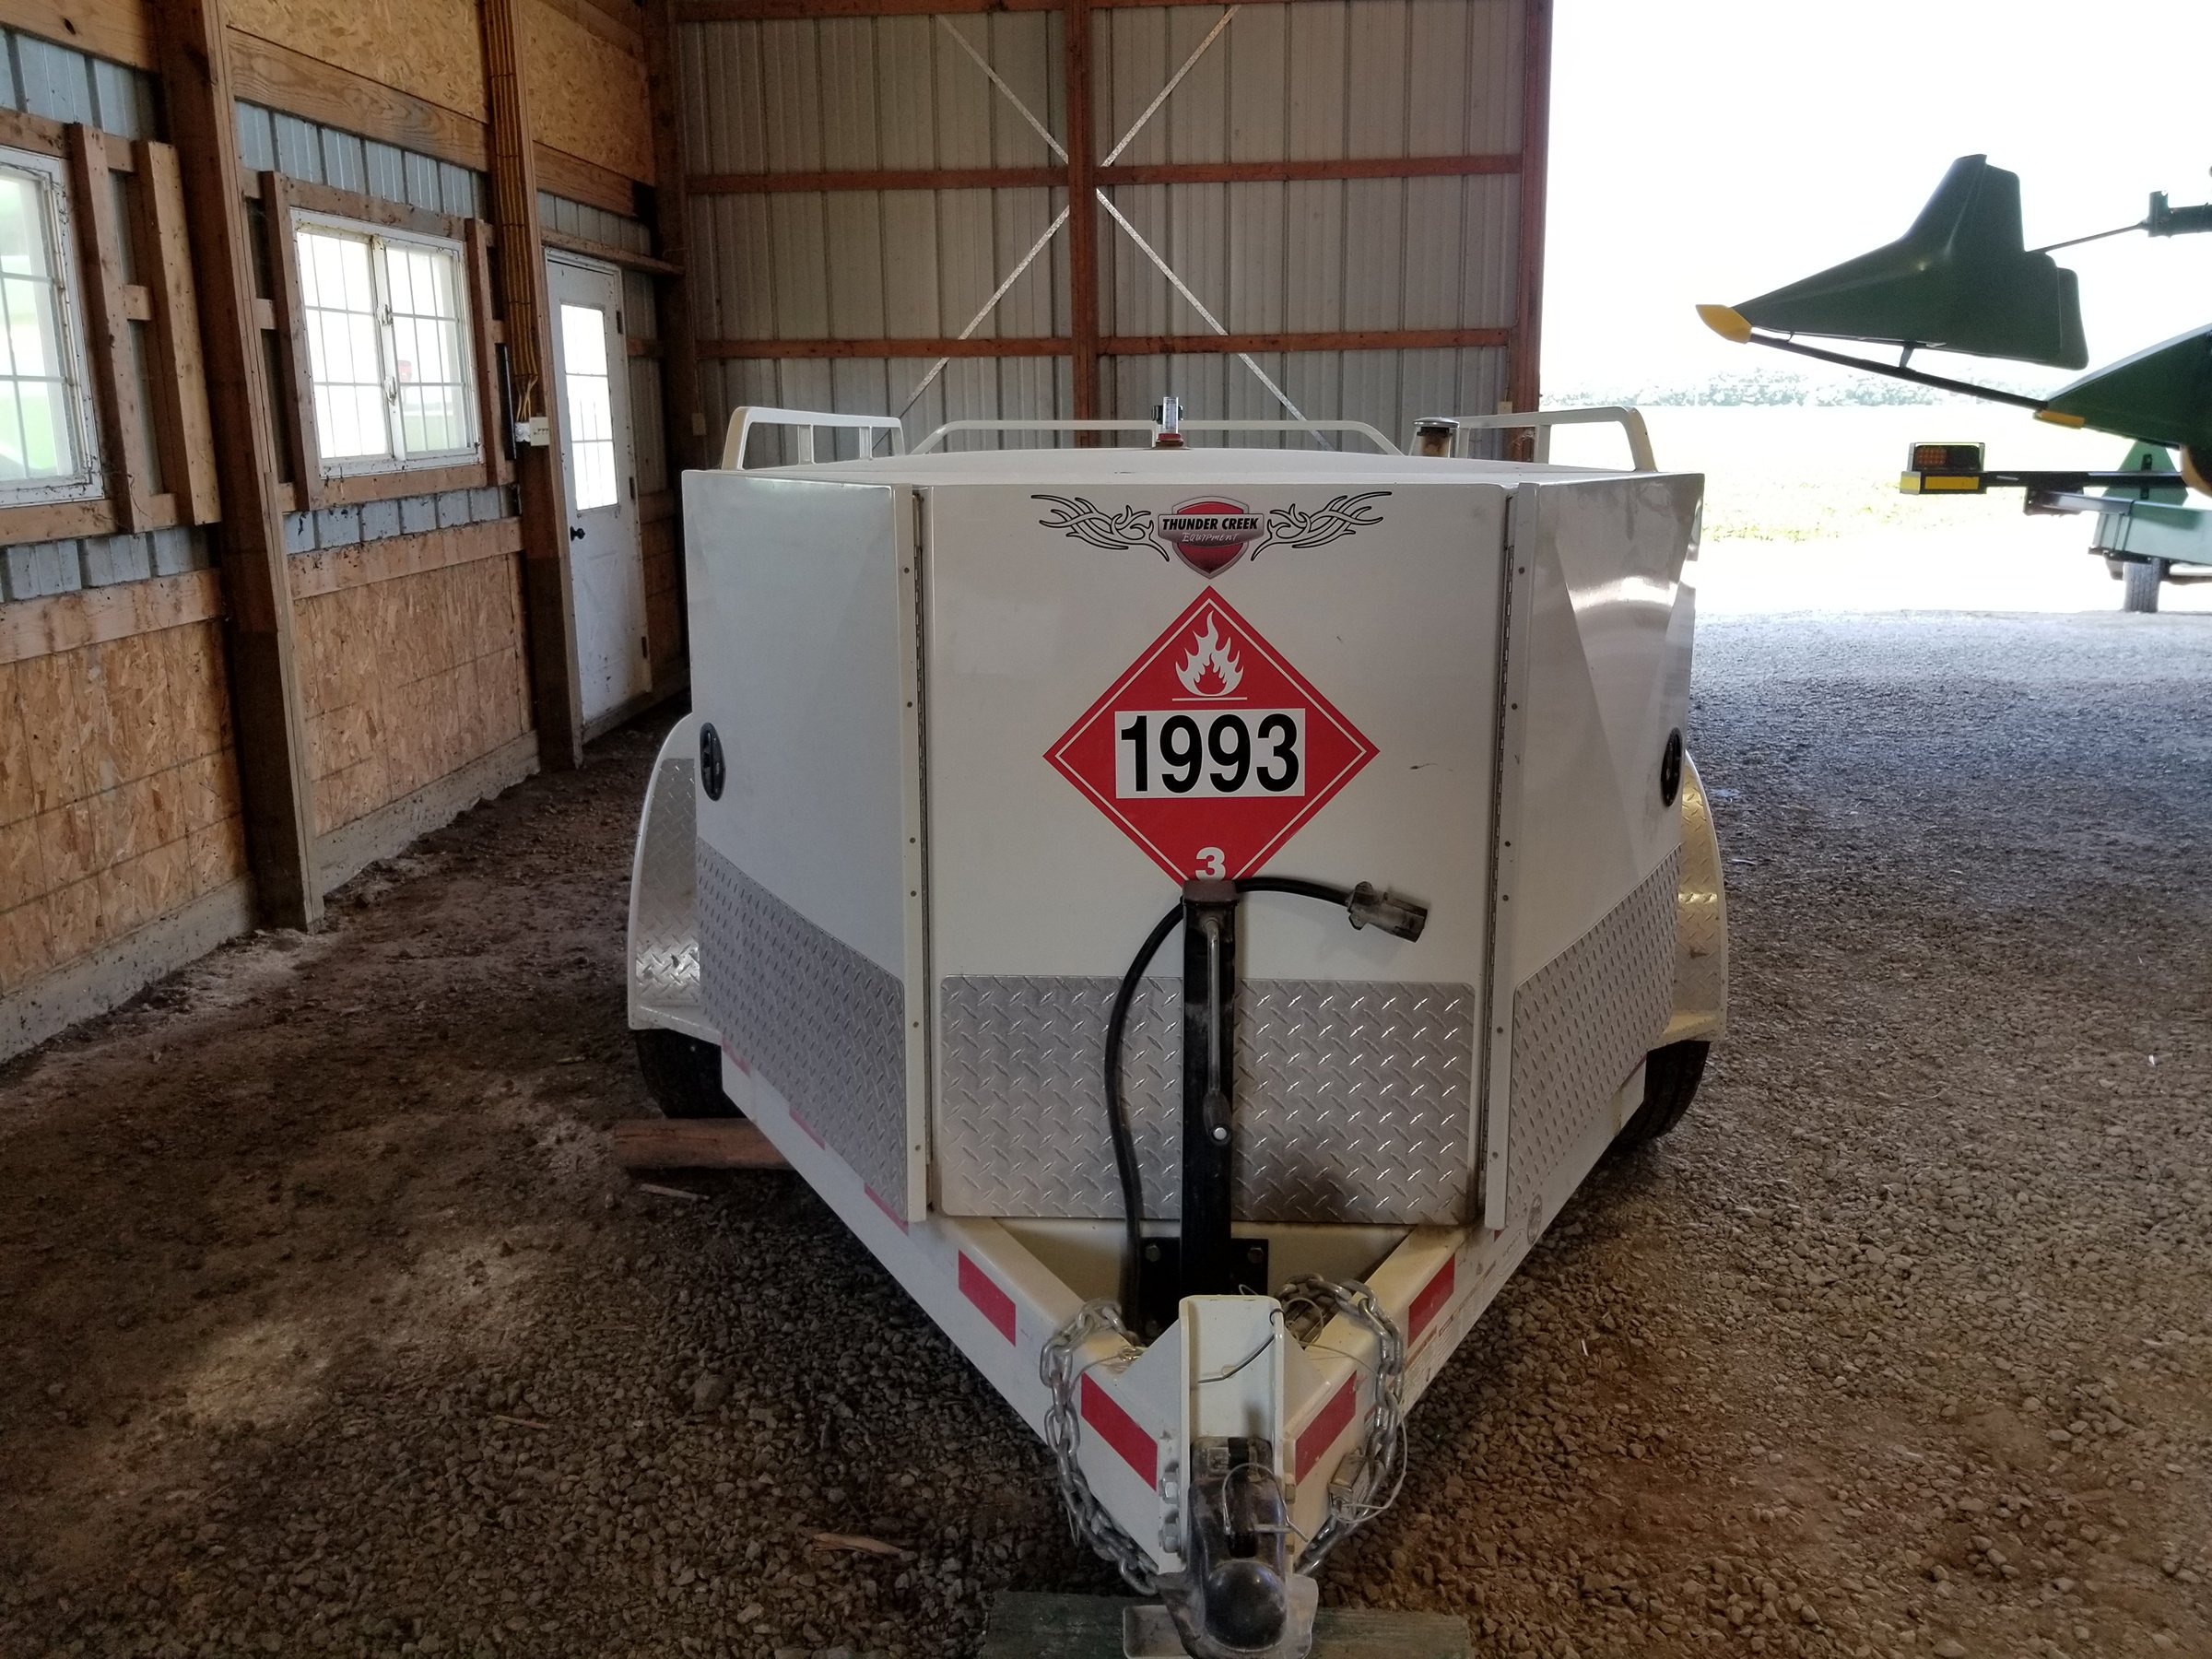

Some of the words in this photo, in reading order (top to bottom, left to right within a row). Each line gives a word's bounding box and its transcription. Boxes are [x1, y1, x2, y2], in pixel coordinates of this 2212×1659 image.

[1162, 518, 1218, 530] THUNDER
[1222, 518, 1259, 530] CREEK
[1121, 713, 1300, 794] 1993
[1194, 846, 1227, 881] 3
